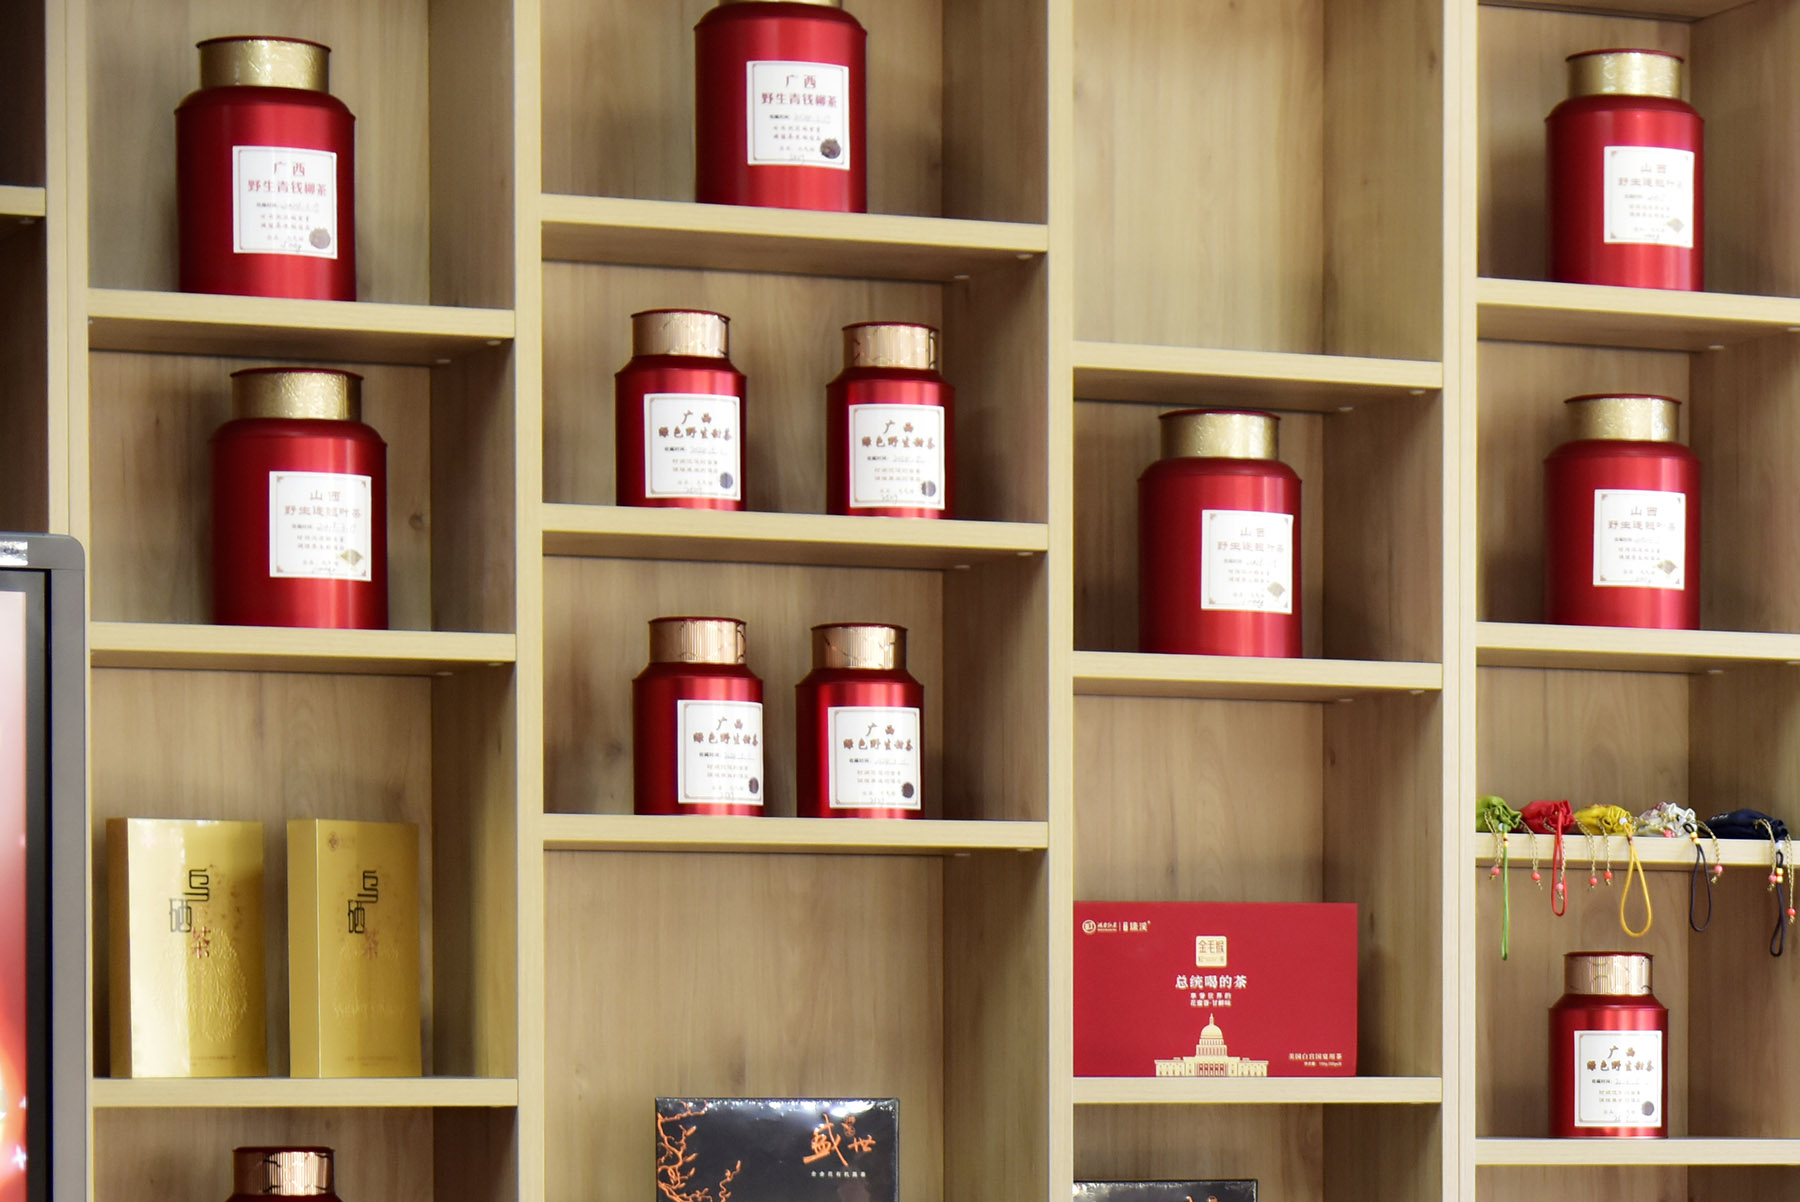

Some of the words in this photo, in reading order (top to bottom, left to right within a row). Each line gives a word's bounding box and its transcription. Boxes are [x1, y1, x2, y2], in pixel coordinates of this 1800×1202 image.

[1175, 975, 1247, 989] 总统喝的茶
[803, 1113, 876, 1167] 盛世
